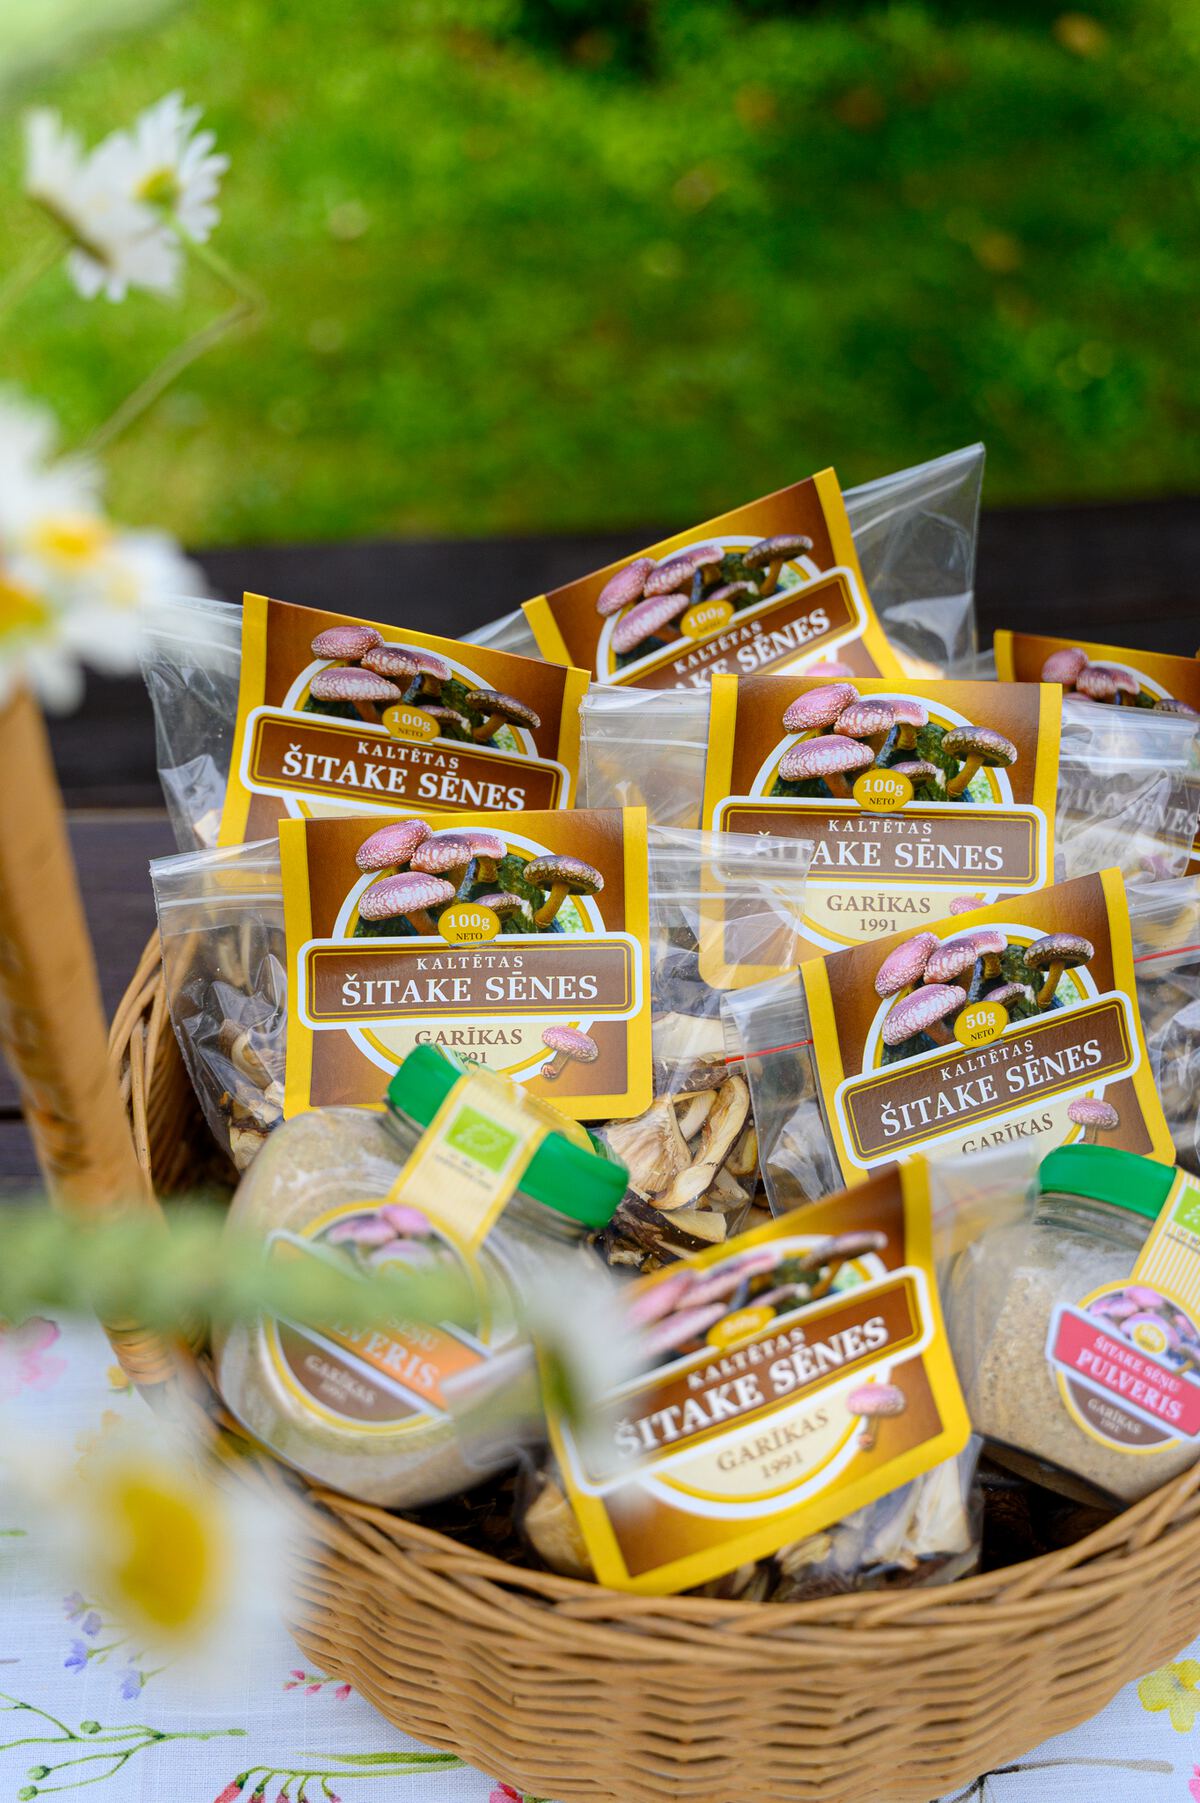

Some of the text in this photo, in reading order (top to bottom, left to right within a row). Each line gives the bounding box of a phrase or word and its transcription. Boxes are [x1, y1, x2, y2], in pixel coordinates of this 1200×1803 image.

[737, 608, 830, 673] SĒNES
[392, 711, 431, 732] 100g
[398, 727, 424, 738] NETO
[357, 741, 460, 769] KALTĒTAS
[282, 743, 526, 811] ŠITAKE SĒNES
[863, 779, 904, 796] 100g
[869, 797, 895, 806] NETO
[828, 819, 932, 835] KALTĒTAS
[895, 838, 1004, 871] SĒNES
[827, 893, 931, 914] GARĪKAS
[447, 913, 491, 931] 100g
[859, 919, 897, 932] 1991
[456, 932, 483, 941] NETO
[416, 954, 523, 970] KALTĒTAS
[342, 971, 598, 1007] ŠITAKE SĒNES
[966, 1010, 996, 1029] 50g
[415, 1027, 522, 1045] GARĪKAS
[970, 1028, 995, 1042] NETO
[940, 1039, 1034, 1081] KALTĒTAS
[880, 1039, 1102, 1137] ŠITAKE SĒNES
[962, 1113, 1053, 1154] GARĪKAS
[614, 1316, 888, 1458] ŠITAKE SĒNES
[1076, 1348, 1184, 1420] PULVERIS
[717, 1408, 829, 1472] GARĪKAS
[761, 1450, 803, 1479] 1991
